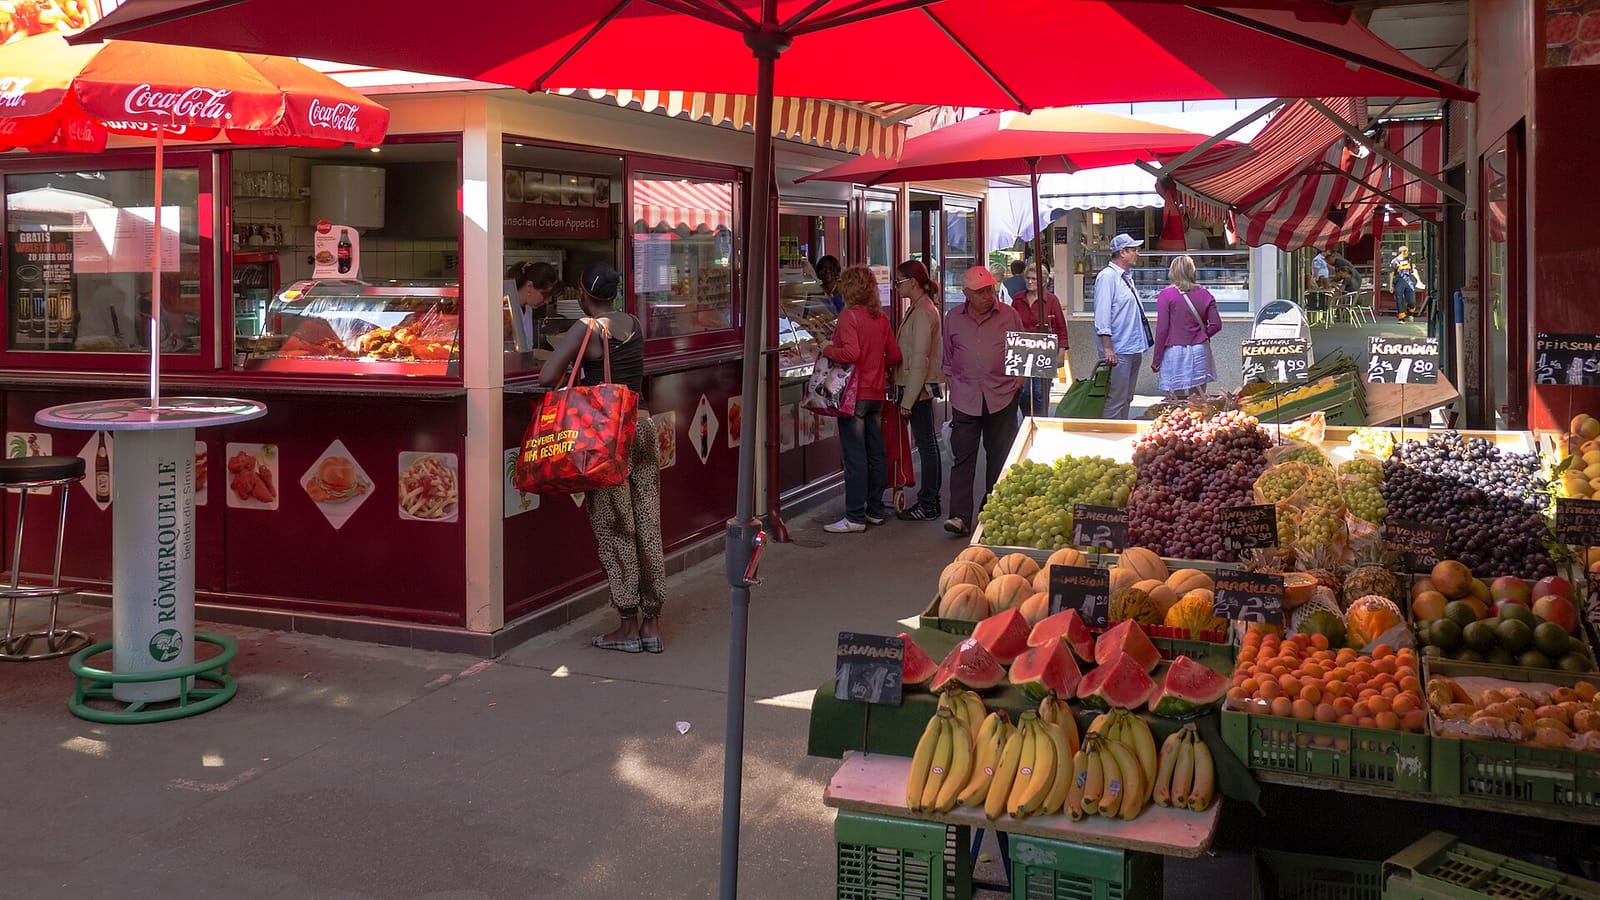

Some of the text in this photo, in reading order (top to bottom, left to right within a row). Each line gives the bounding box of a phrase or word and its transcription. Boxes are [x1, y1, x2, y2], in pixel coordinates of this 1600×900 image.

[125, 83, 232, 120] Coca-Cola
[309, 98, 360, 132] Coca-Cola
[538, 216, 564, 228] Guten
[19, 232, 51, 243] GRATIS
[1242, 344, 1304, 357] KERNLOSE
[153, 462, 180, 624] RÖMERQUELLE
